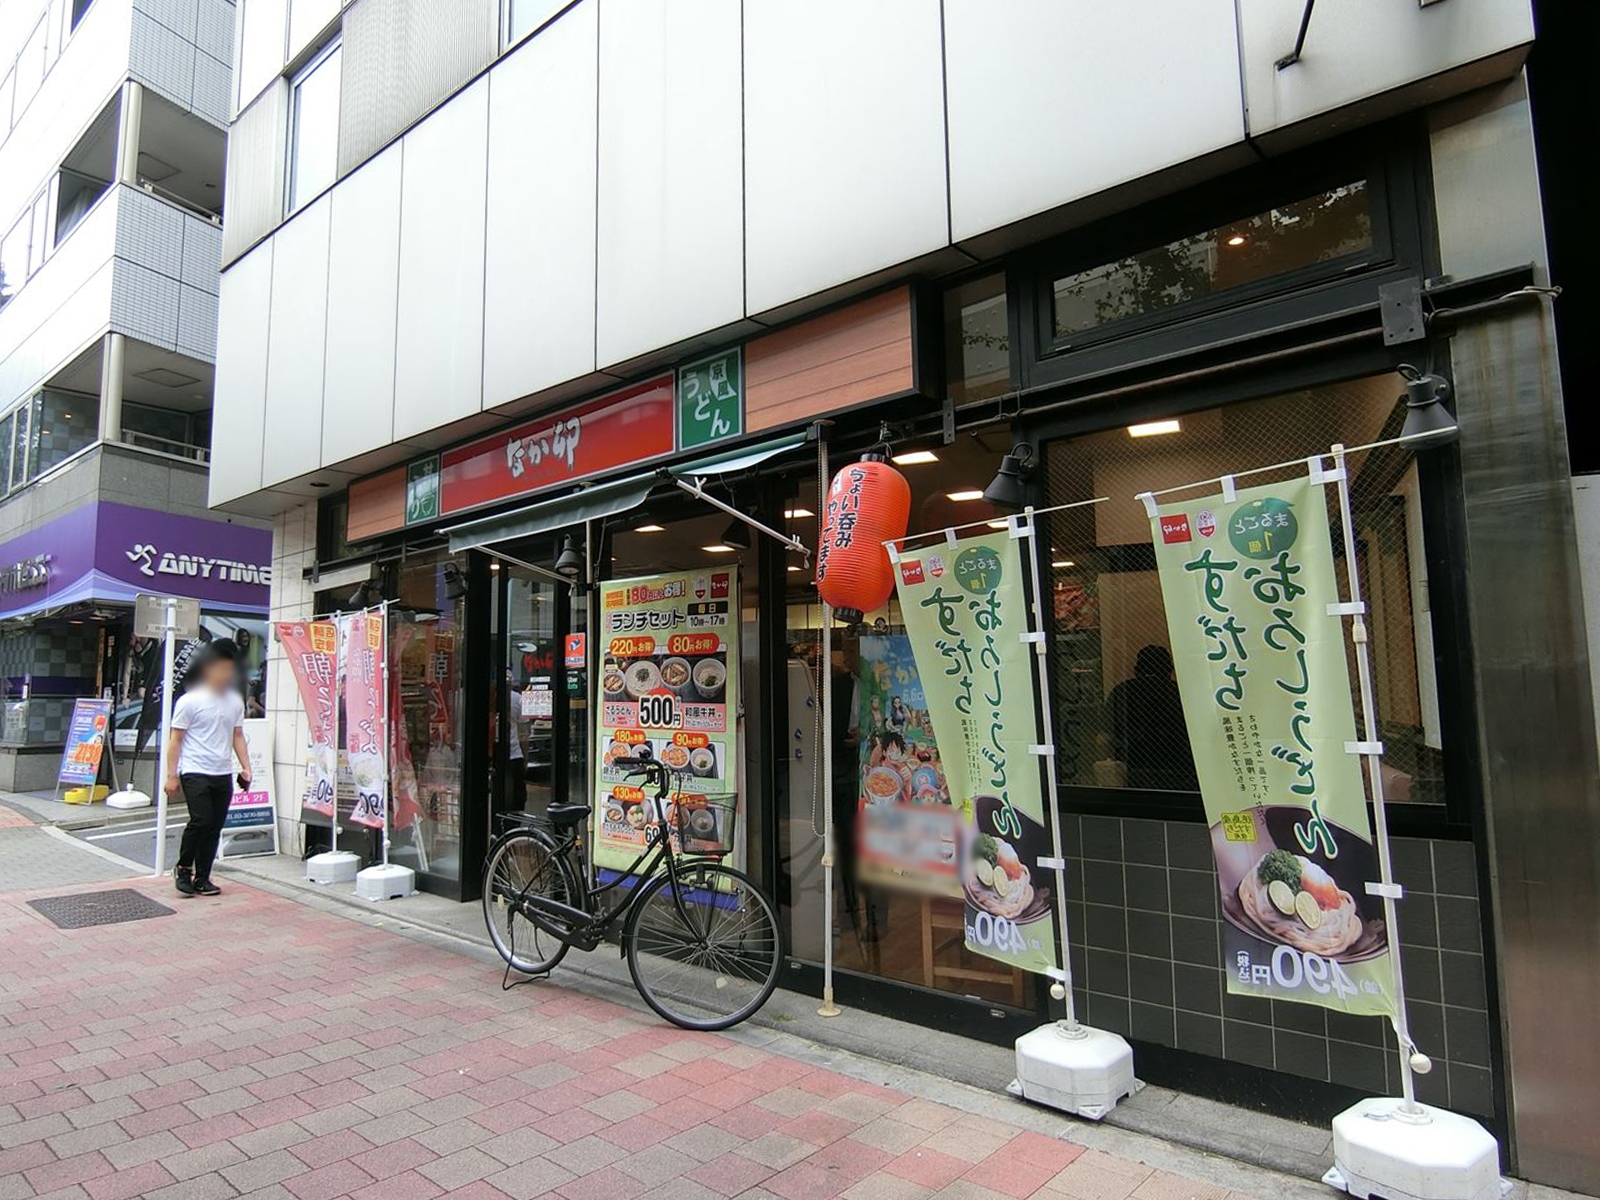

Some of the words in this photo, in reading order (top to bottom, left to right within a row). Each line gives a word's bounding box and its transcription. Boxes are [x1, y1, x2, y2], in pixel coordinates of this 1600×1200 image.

[684, 371, 731, 438] うどん
[506, 417, 581, 478] なか卯
[834, 468, 867, 549] ちょい呑み
[158, 552, 272, 586] ANYTIME
[817, 499, 838, 581] やってます
[612, 607, 685, 630] ランチセット
[640, 697, 682, 726] 500円
